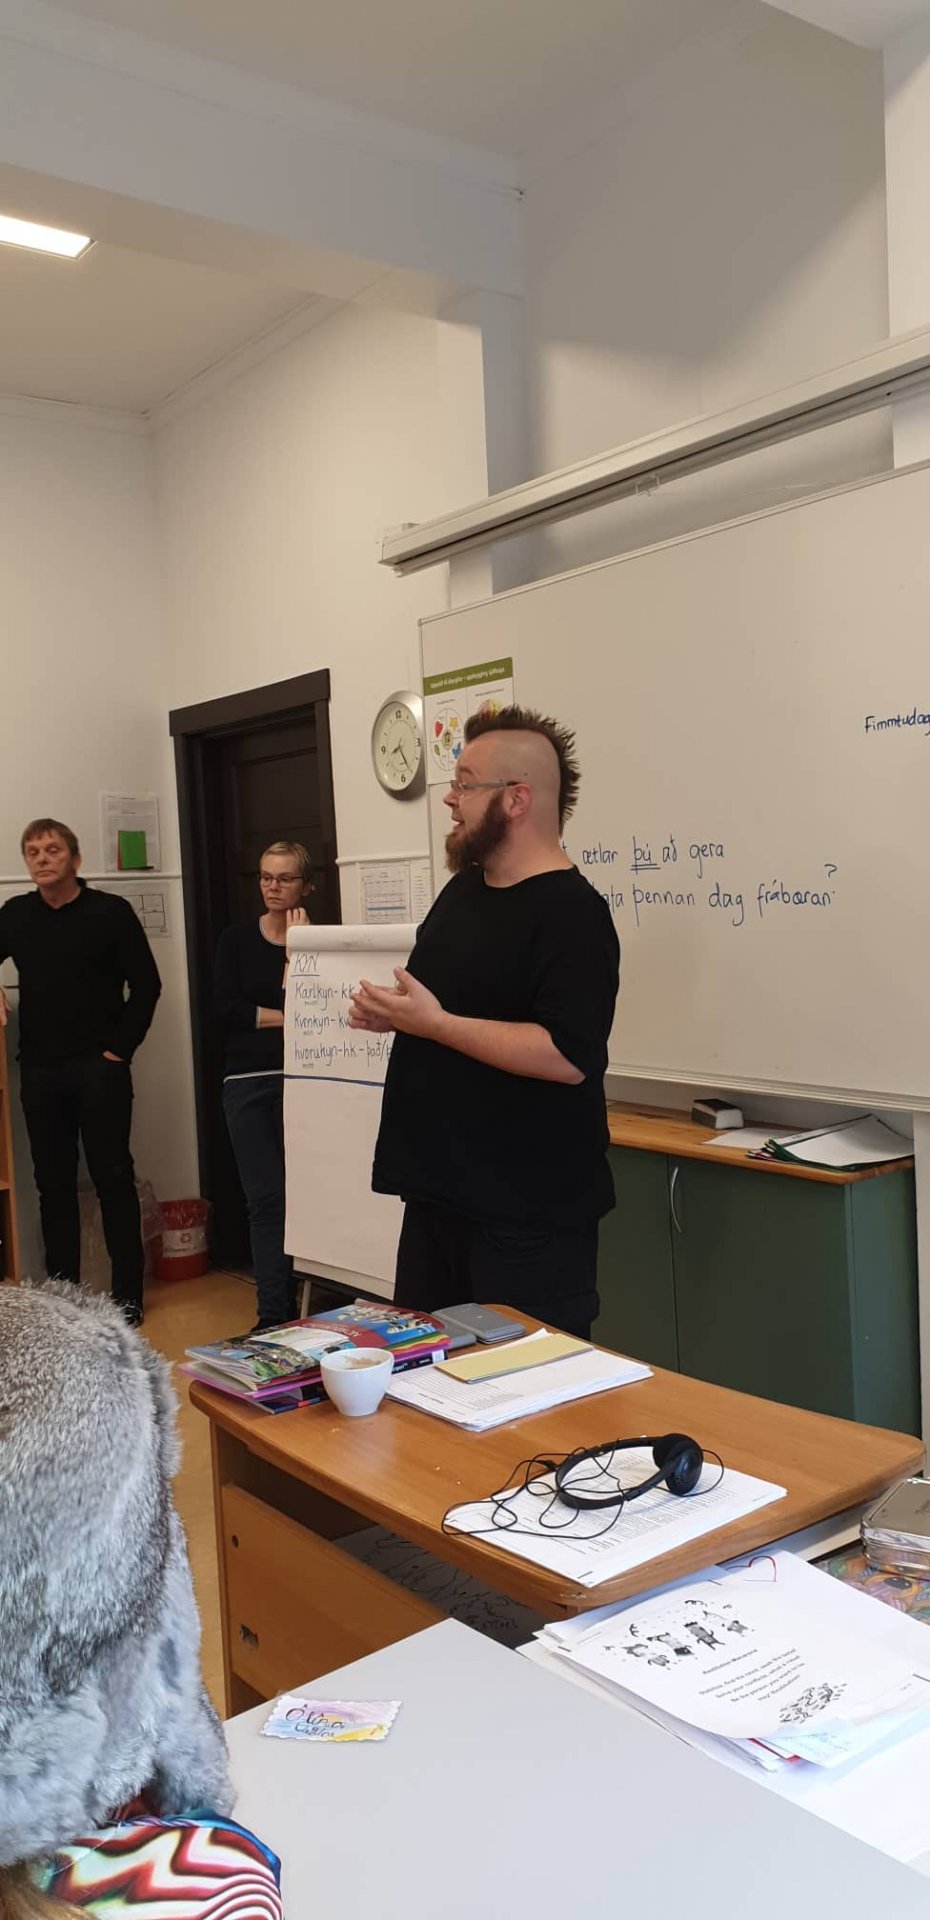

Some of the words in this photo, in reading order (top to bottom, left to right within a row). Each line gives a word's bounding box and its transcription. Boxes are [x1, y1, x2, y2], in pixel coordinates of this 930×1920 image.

[395, 709, 402, 719] 12
[416, 737, 421, 748] 3
[380, 745, 387, 755] 9
[400, 773, 407, 783] 6
[582, 841, 618, 865] ætlar
[662, 834, 678, 863] að
[689, 843, 724, 879] gera
[632, 883, 695, 927] þennan
[708, 882, 744, 926] dag
